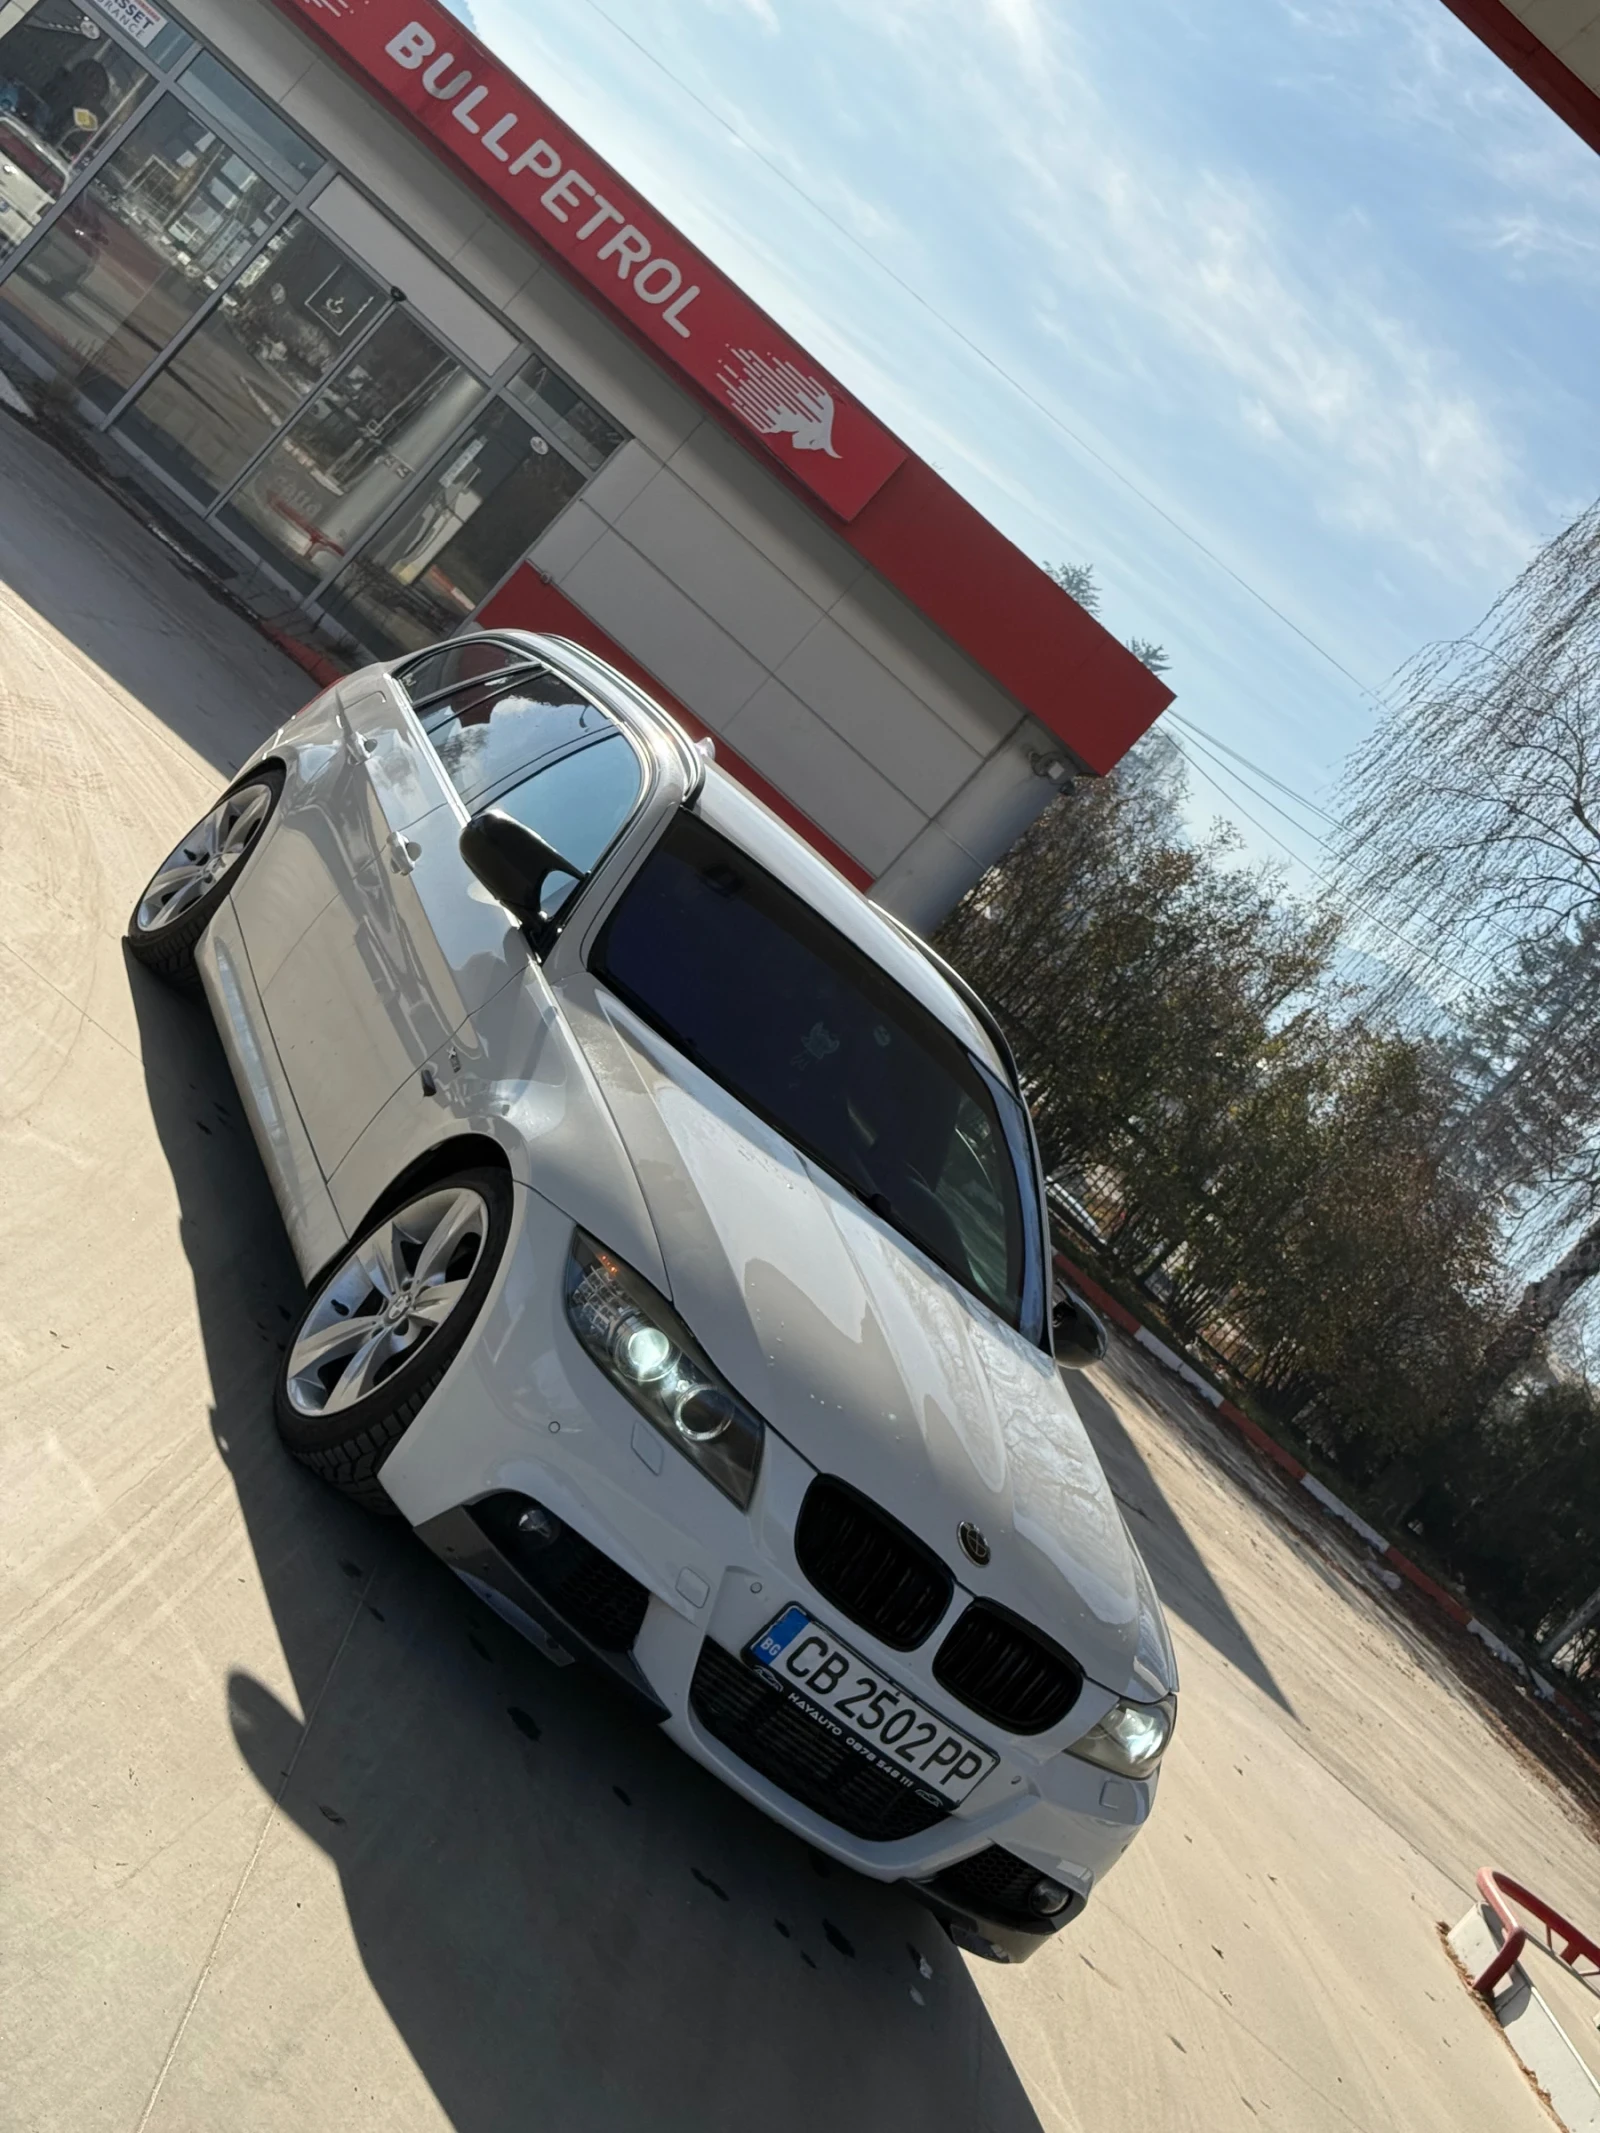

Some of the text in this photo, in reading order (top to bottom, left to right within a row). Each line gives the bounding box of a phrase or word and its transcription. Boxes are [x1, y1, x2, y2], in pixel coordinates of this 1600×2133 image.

[115, 0, 154, 29] SSET
[384, 21, 700, 339] BULLPETROL
[760, 1637, 782, 1656] BG
[786, 1636, 849, 1695] CB
[833, 1677, 937, 1763] 2502
